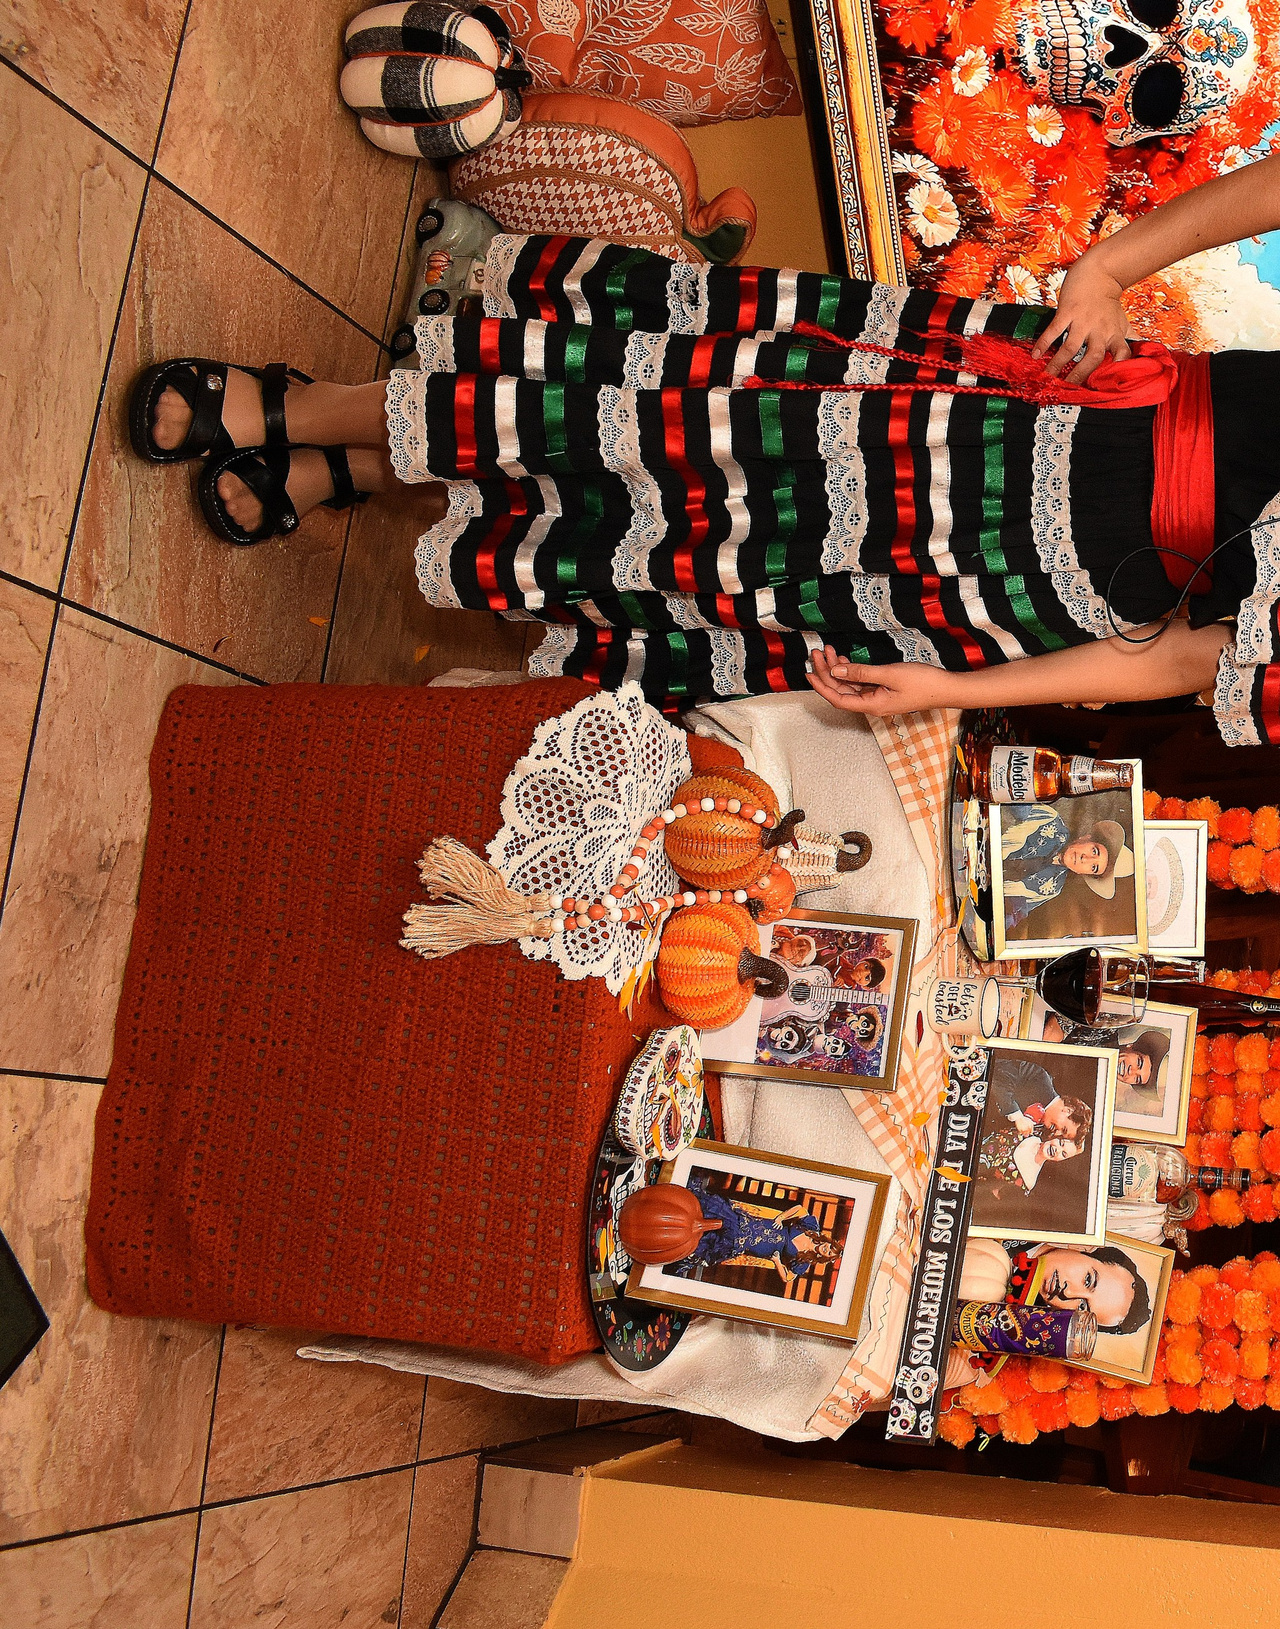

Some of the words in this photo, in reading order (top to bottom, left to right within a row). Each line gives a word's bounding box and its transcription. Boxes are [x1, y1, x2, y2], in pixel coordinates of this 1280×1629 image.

[1012, 755, 1029, 797] Modelo
[935, 981, 952, 1025] toasted
[947, 986, 960, 1002] GET
[960, 983, 978, 1007] let's
[944, 1112, 971, 1152] DIA
[1124, 1156, 1138, 1185] Cuervo
[929, 1198, 957, 1243] LOS
[909, 1249, 948, 1365] MUERTOS
[963, 1312, 980, 1347] MUERTOS
